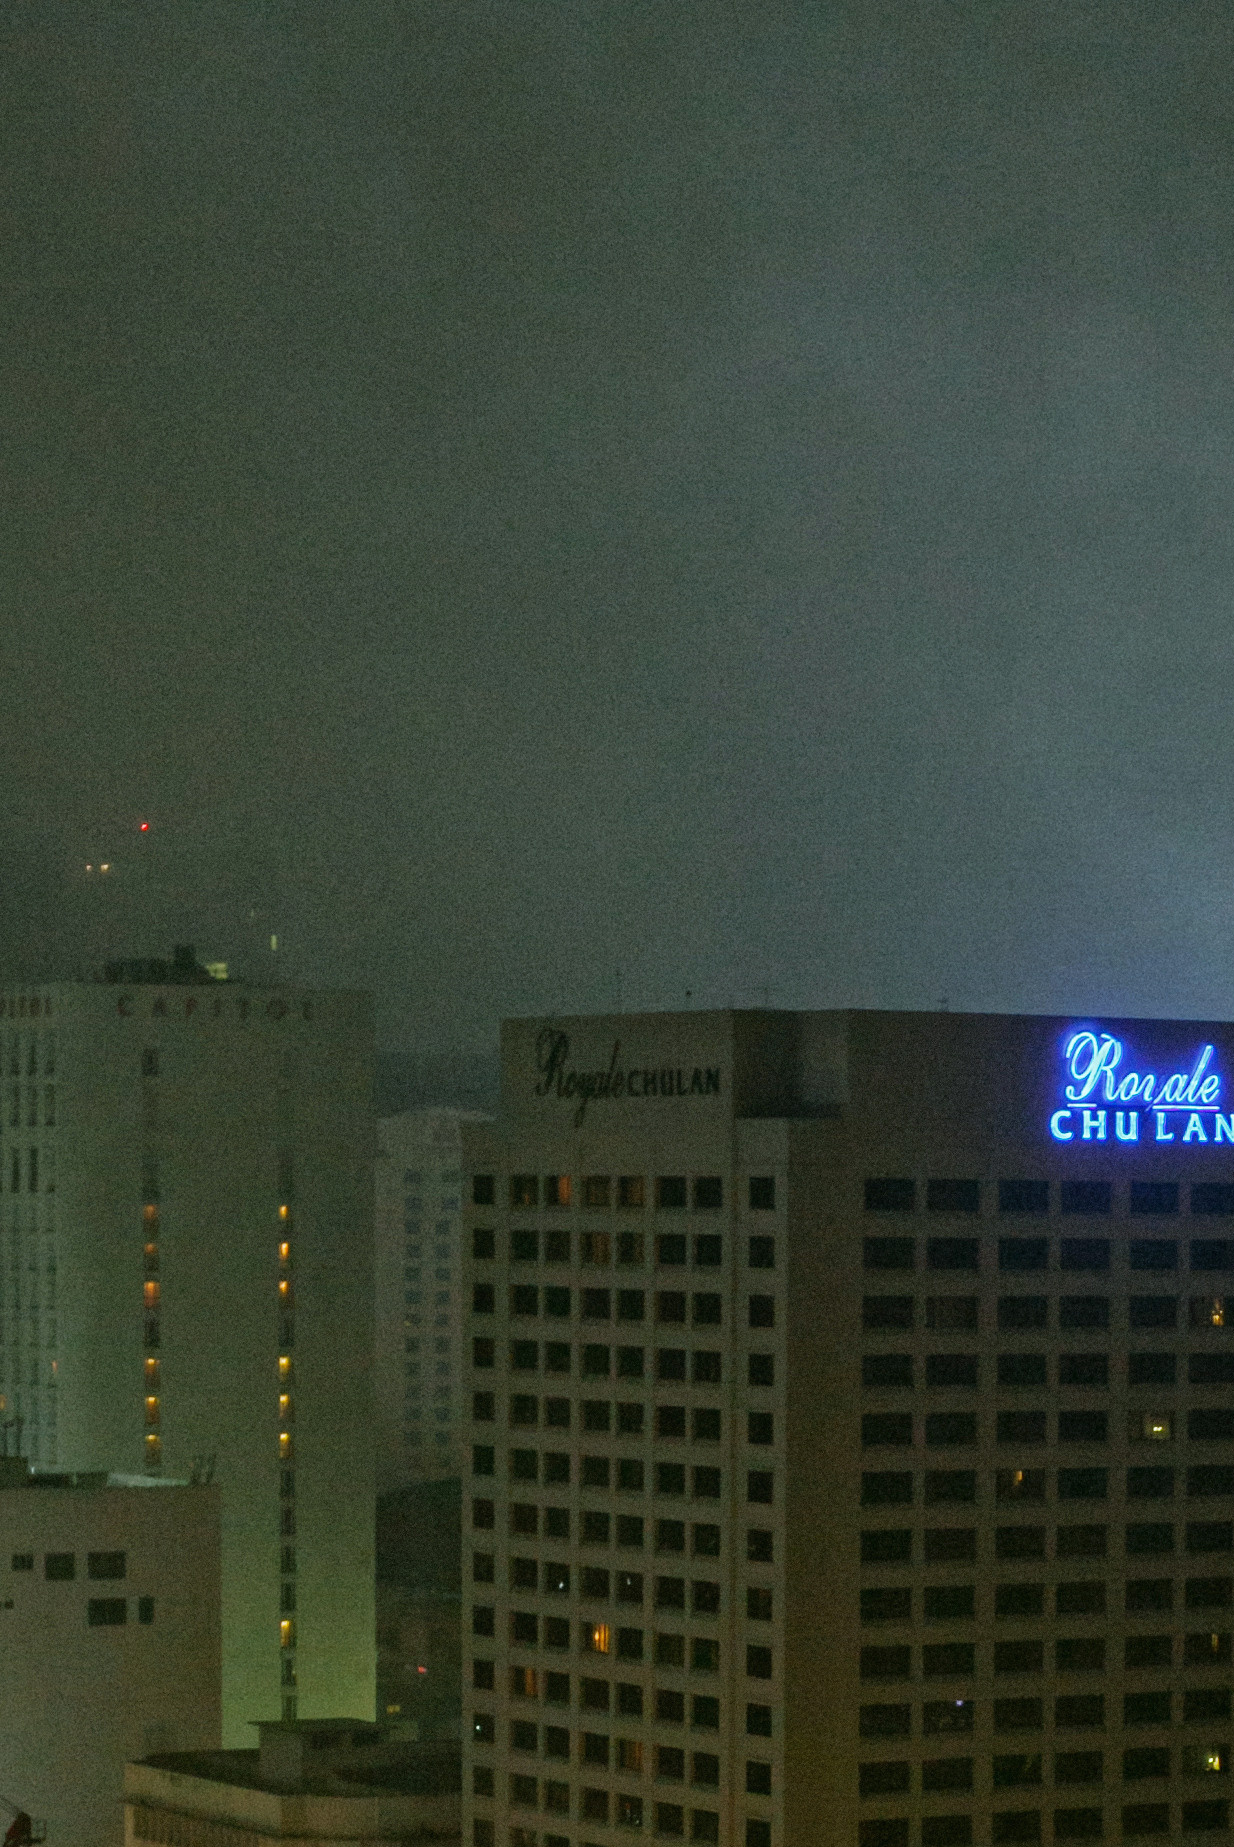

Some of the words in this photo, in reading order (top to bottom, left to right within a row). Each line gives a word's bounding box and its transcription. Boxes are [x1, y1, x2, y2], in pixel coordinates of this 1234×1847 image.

[534, 1028, 625, 1129] Royale
[626, 1067, 720, 1097] CHULAN
[1066, 1031, 1220, 1111] Royale
